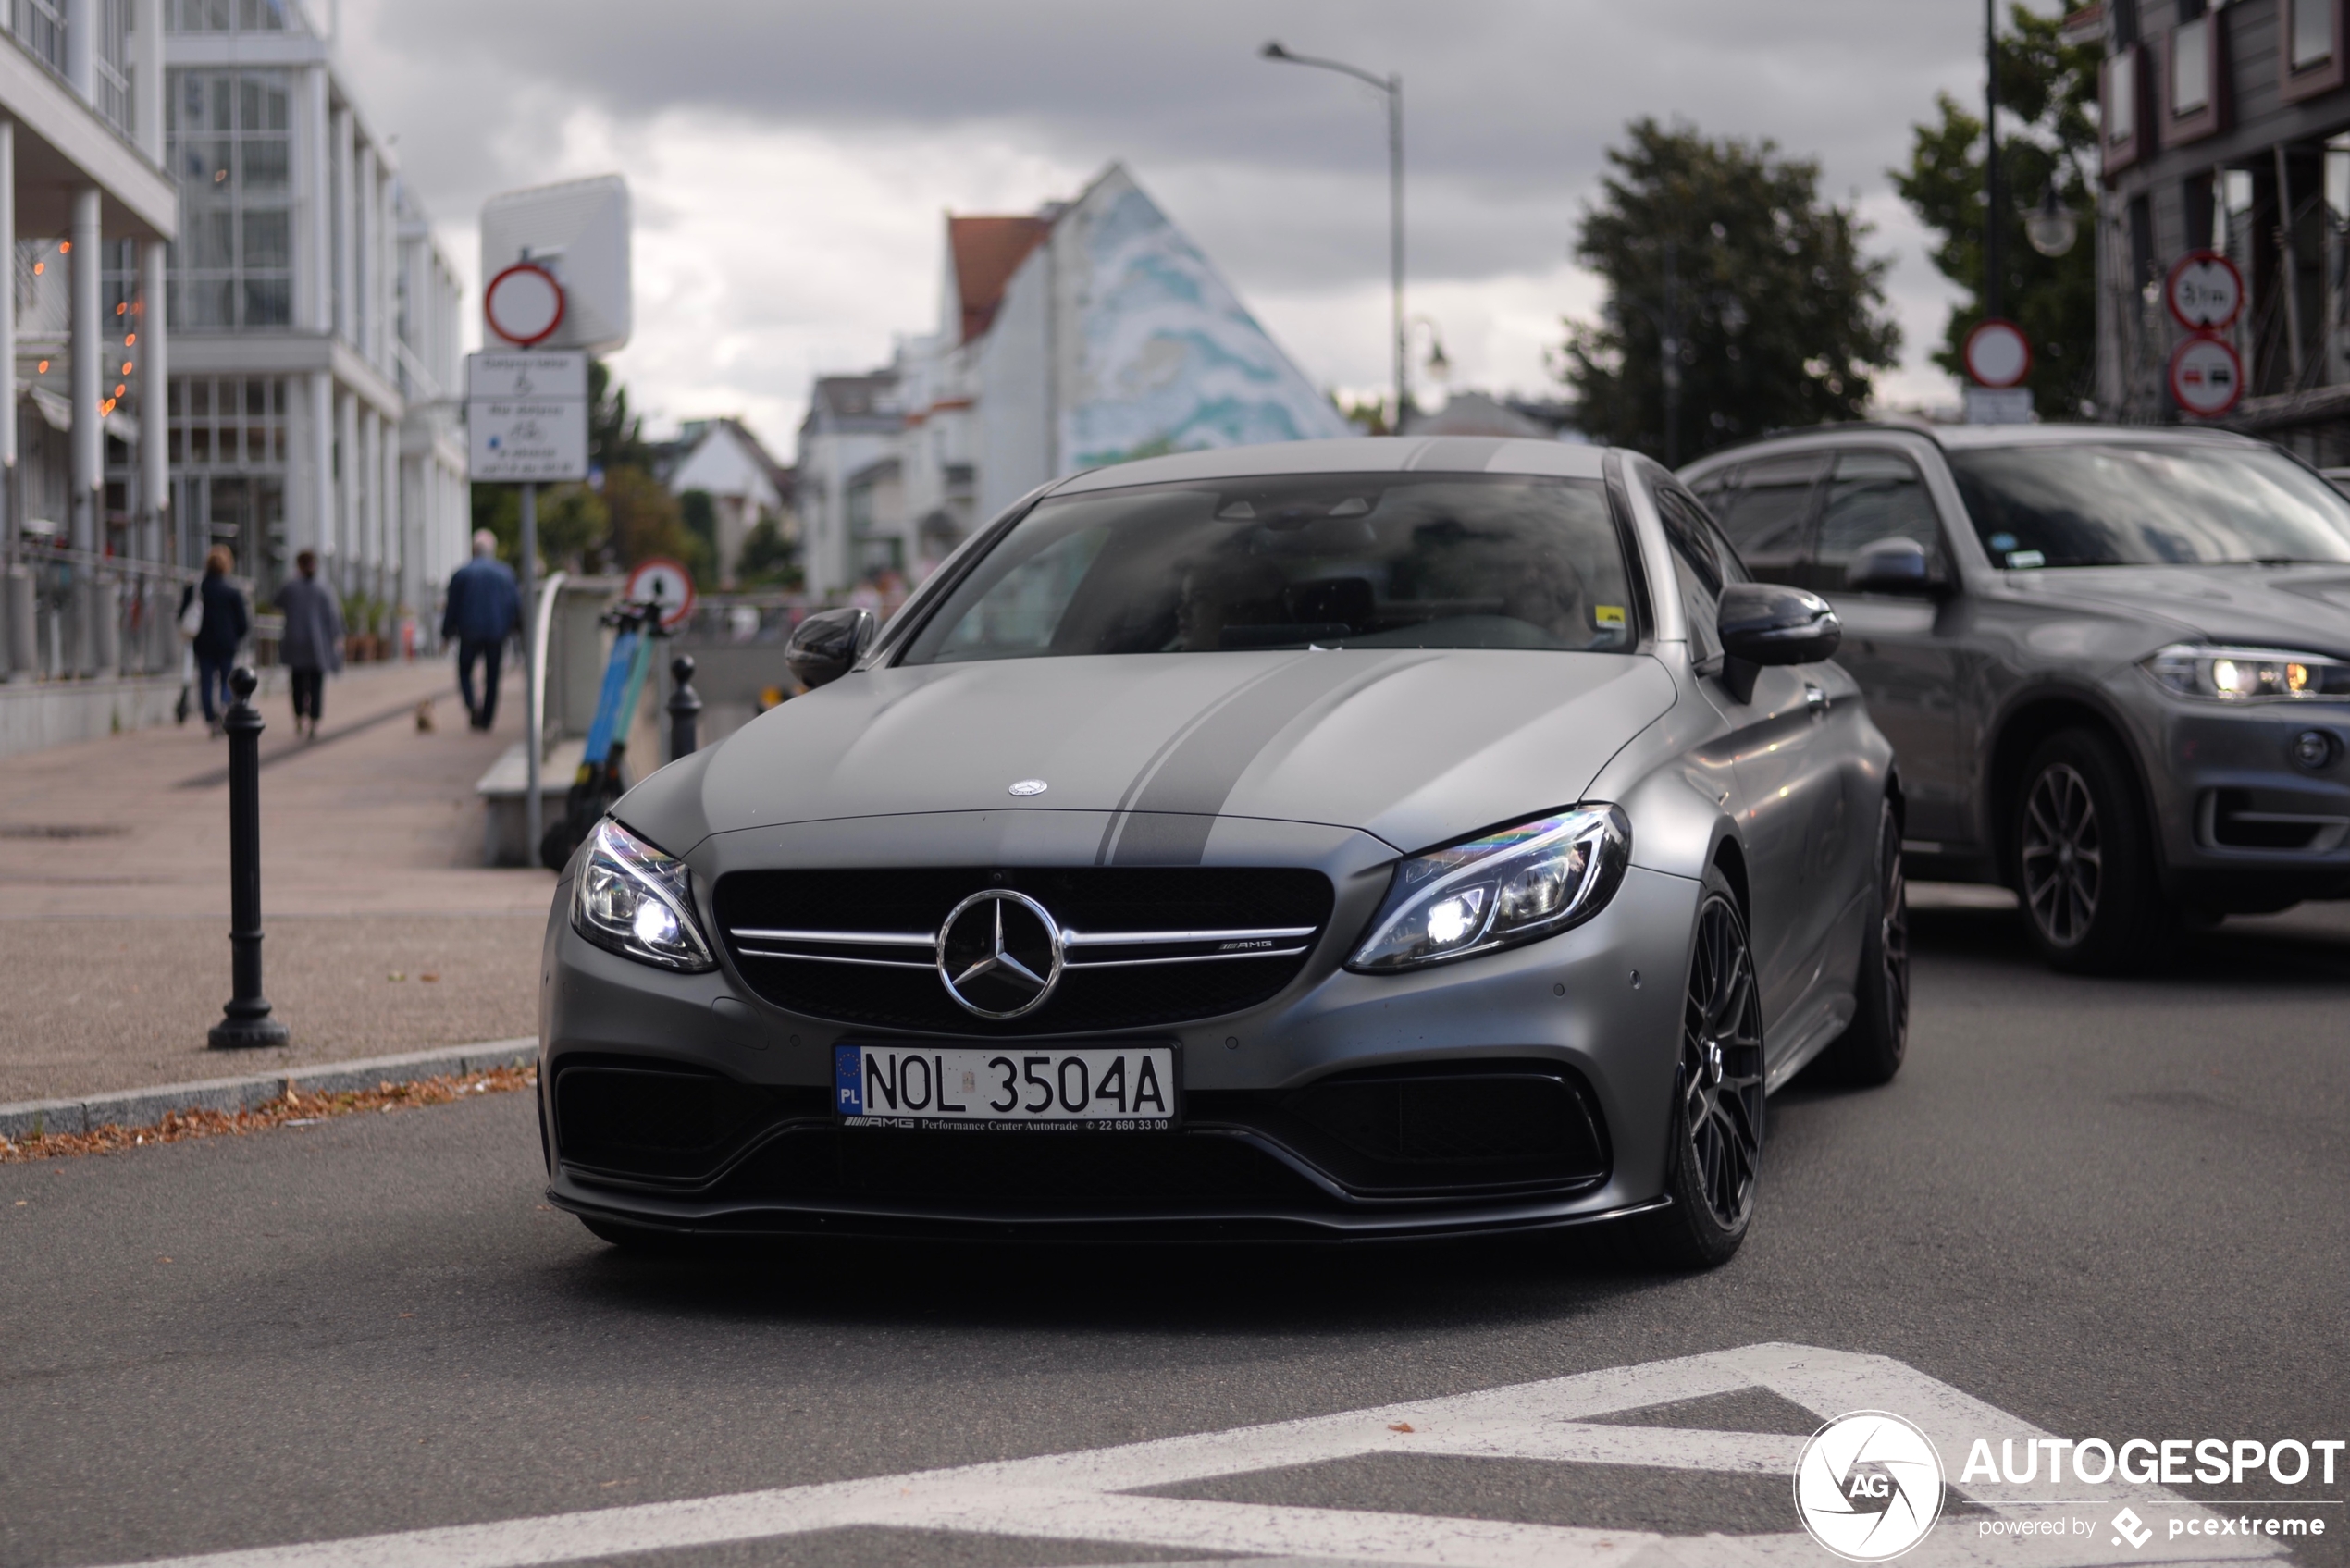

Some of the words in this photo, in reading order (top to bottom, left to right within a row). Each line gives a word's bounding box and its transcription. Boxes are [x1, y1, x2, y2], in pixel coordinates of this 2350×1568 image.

[1236, 941, 1272, 949] AMG
[865, 1053, 967, 1112] NOL
[987, 1055, 1166, 1113] 3504A
[840, 1088, 860, 1105] PL
[866, 1117, 915, 1129] AMG
[922, 1119, 985, 1130] Performance
[988, 1120, 1023, 1131] Center
[1025, 1121, 1079, 1131] Autotrade
[1099, 1120, 1112, 1130] 22
[1116, 1120, 1135, 1130] 660
[1138, 1120, 1152, 1130] 33
[1155, 1119, 1169, 1130] 00
